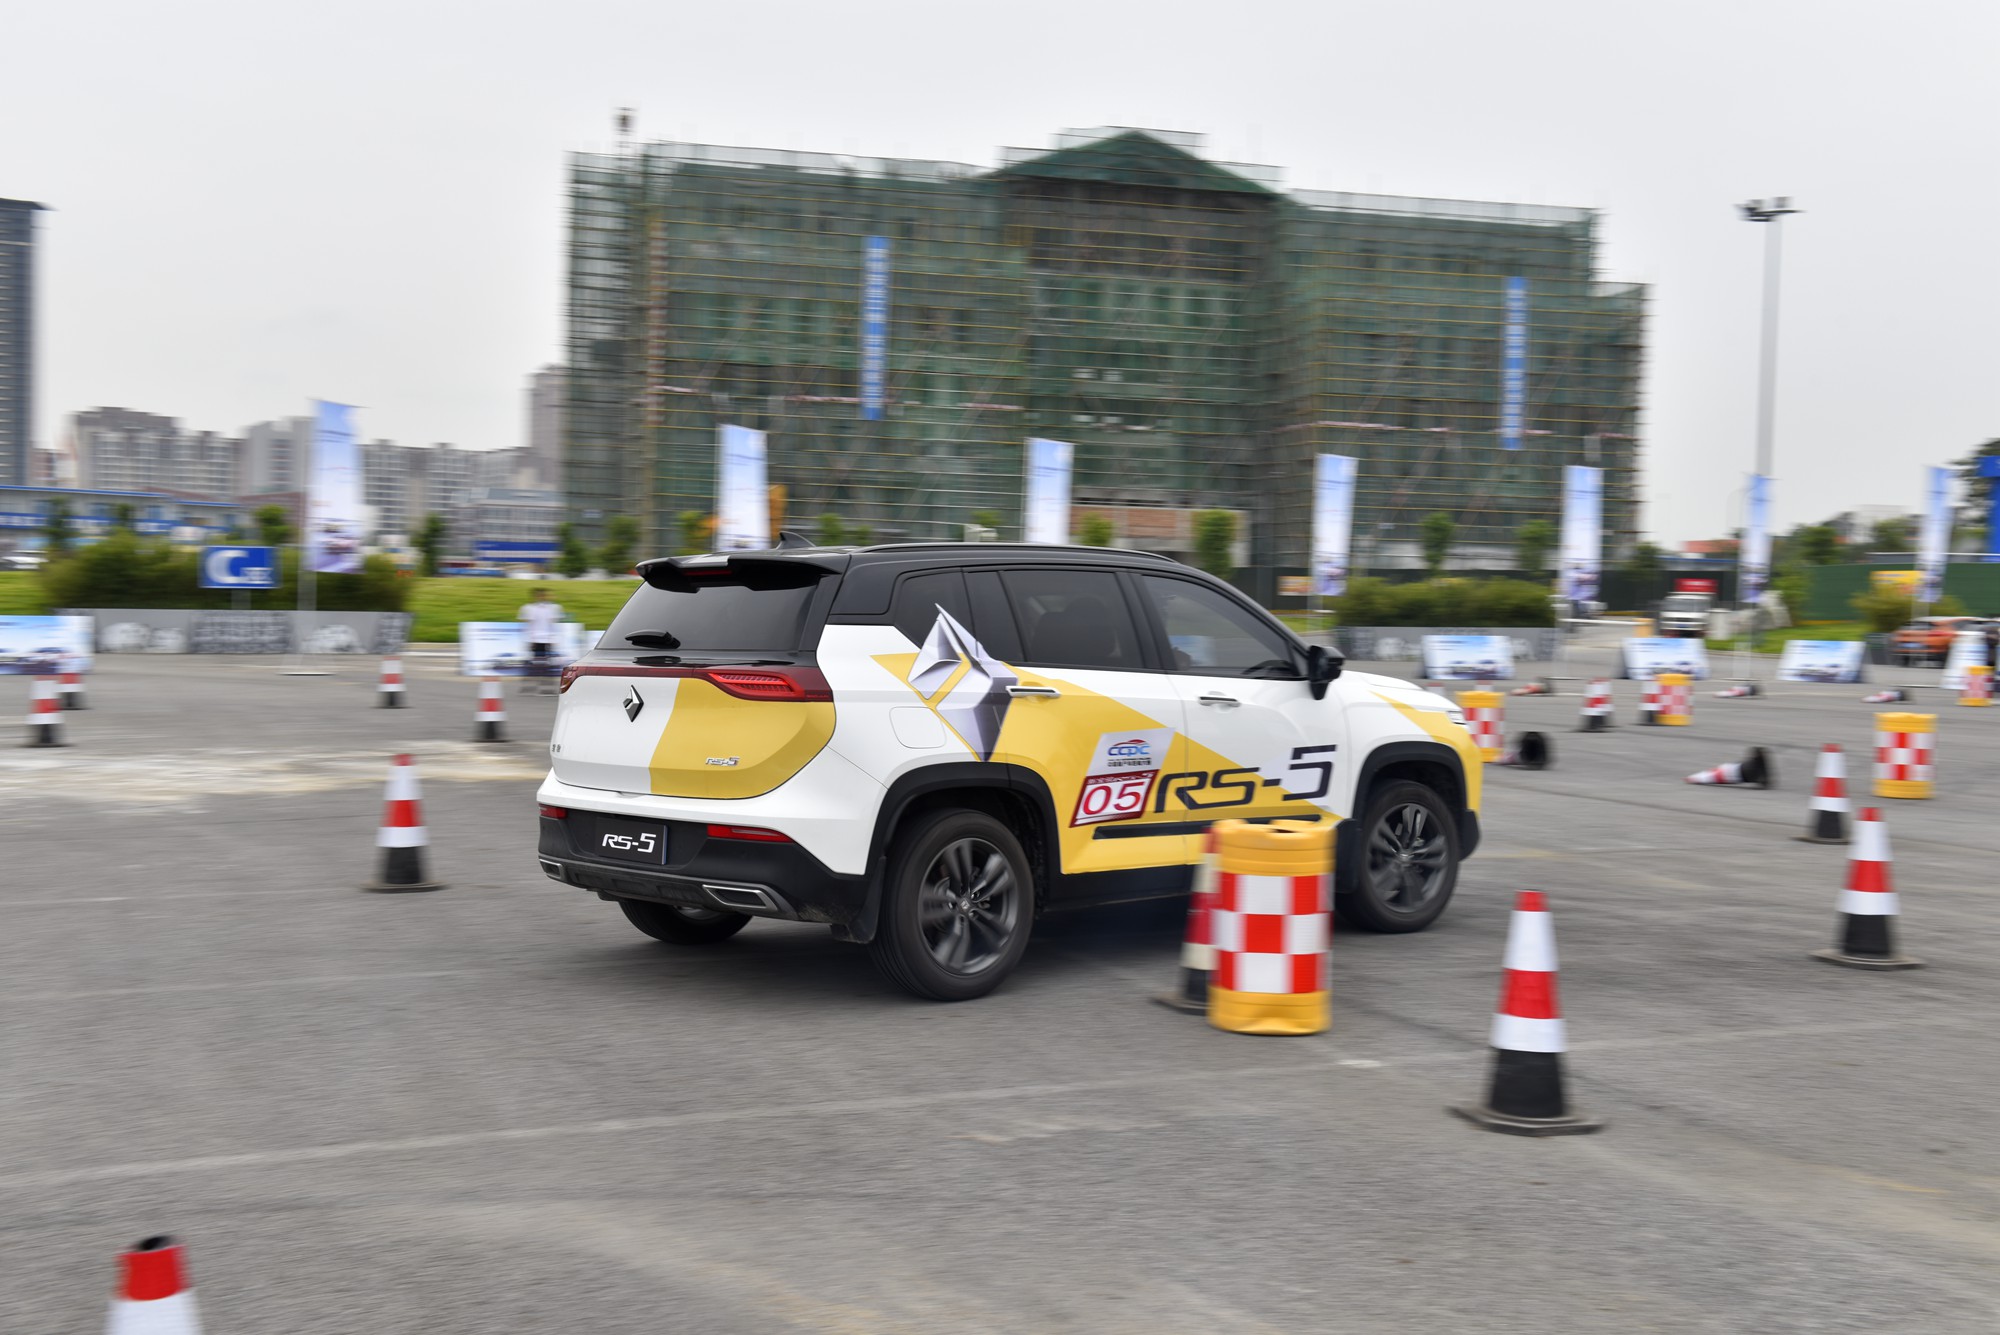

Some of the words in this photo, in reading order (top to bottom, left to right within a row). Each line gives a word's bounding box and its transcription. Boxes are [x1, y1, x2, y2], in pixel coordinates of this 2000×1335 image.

[705, 756, 740, 766] RS-5
[1153, 744, 1337, 813] RS-5
[1083, 782, 1145, 815] 05
[602, 832, 657, 853] RS-5
